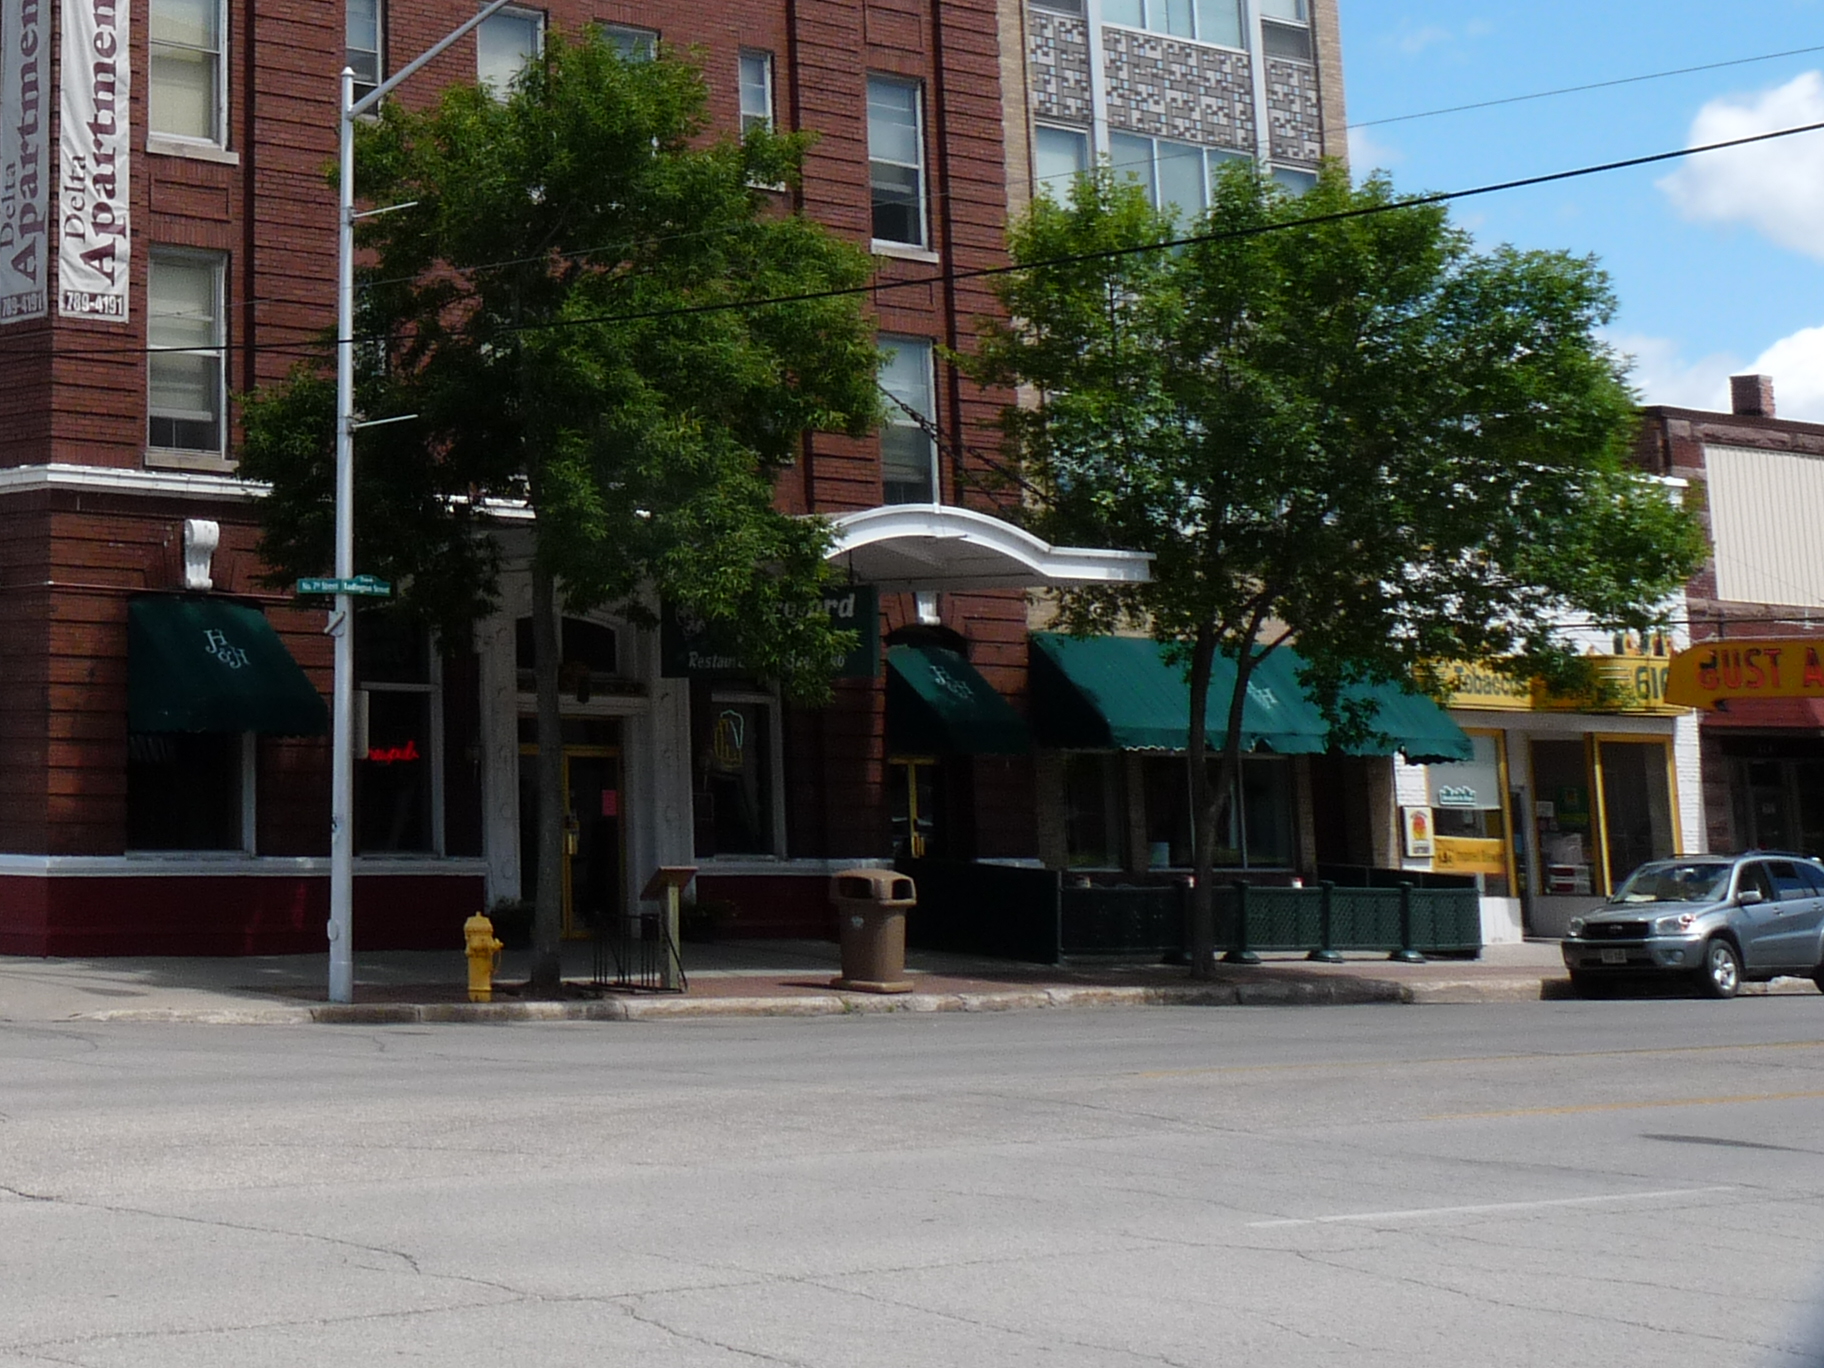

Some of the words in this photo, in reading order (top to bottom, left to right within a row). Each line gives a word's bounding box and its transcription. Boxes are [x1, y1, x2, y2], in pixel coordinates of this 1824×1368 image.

[0, 161, 16, 248] Delta
[63, 154, 86, 244] Delta
[2, 292, 42, 317] 789-4191
[66, 291, 123, 315] 789-4191
